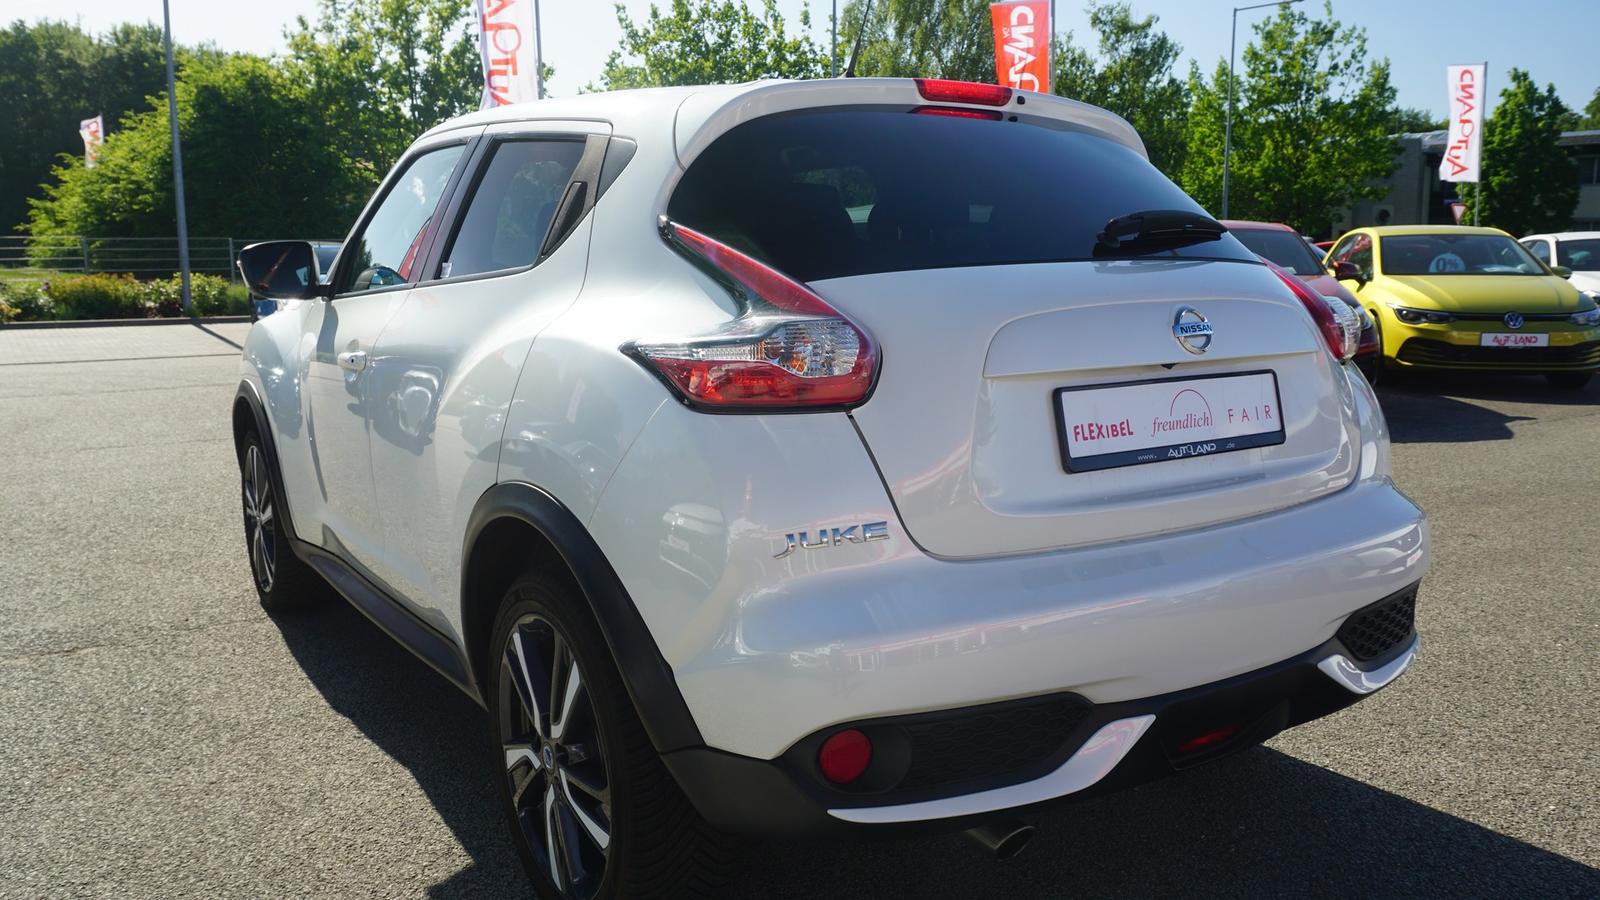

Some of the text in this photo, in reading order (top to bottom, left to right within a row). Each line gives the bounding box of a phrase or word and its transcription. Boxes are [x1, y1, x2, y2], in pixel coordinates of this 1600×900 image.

[1179, 324, 1213, 334] NISSAN
[1073, 404, 1272, 442] FLEXIBEL freundlich FAIR
[1167, 442, 1217, 458] AUTOLAND
[772, 521, 890, 560] JUKE
